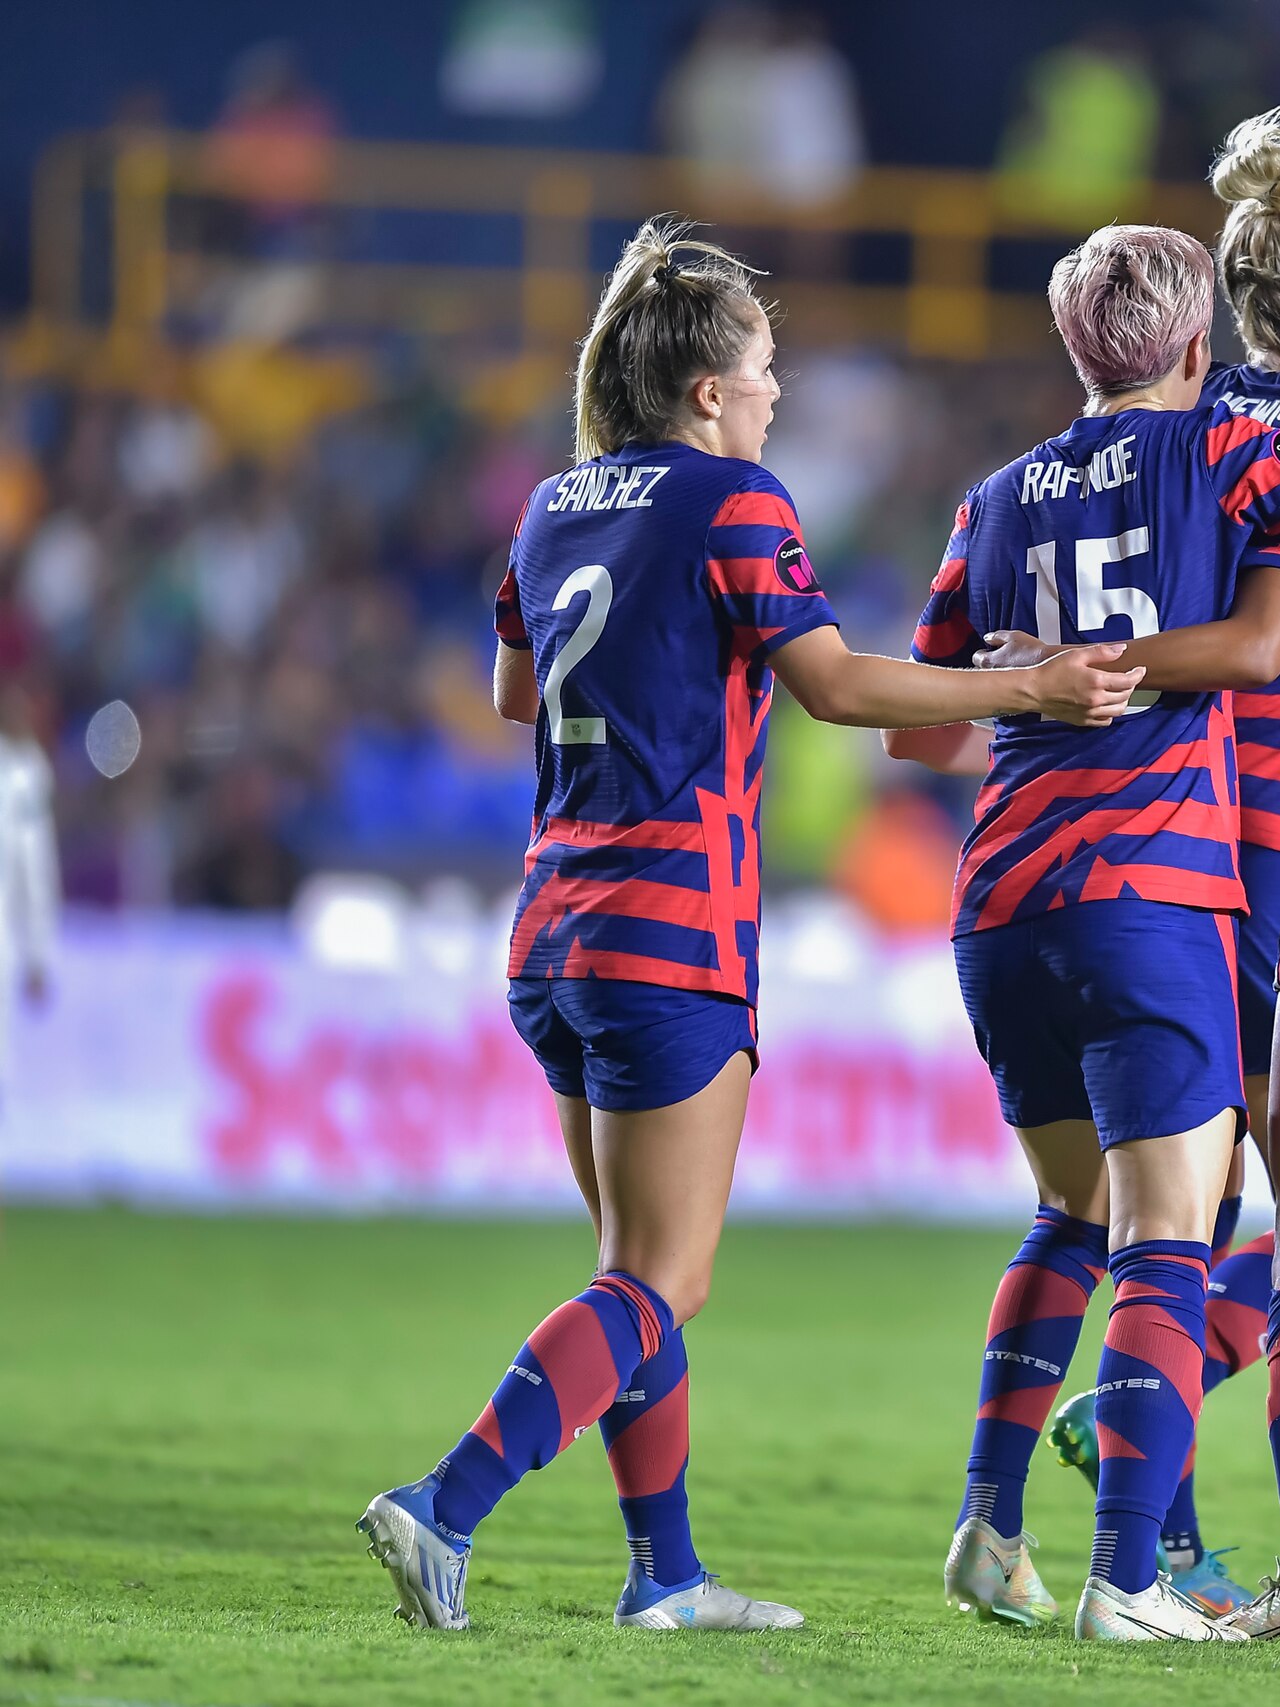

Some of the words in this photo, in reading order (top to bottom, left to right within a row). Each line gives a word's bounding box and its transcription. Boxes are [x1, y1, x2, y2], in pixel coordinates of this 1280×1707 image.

[547, 466, 671, 512] SANCHEZ
[543, 564, 613, 745] 2
[1026, 526, 1162, 722] 15
[985, 1351, 1061, 1376] STATES
